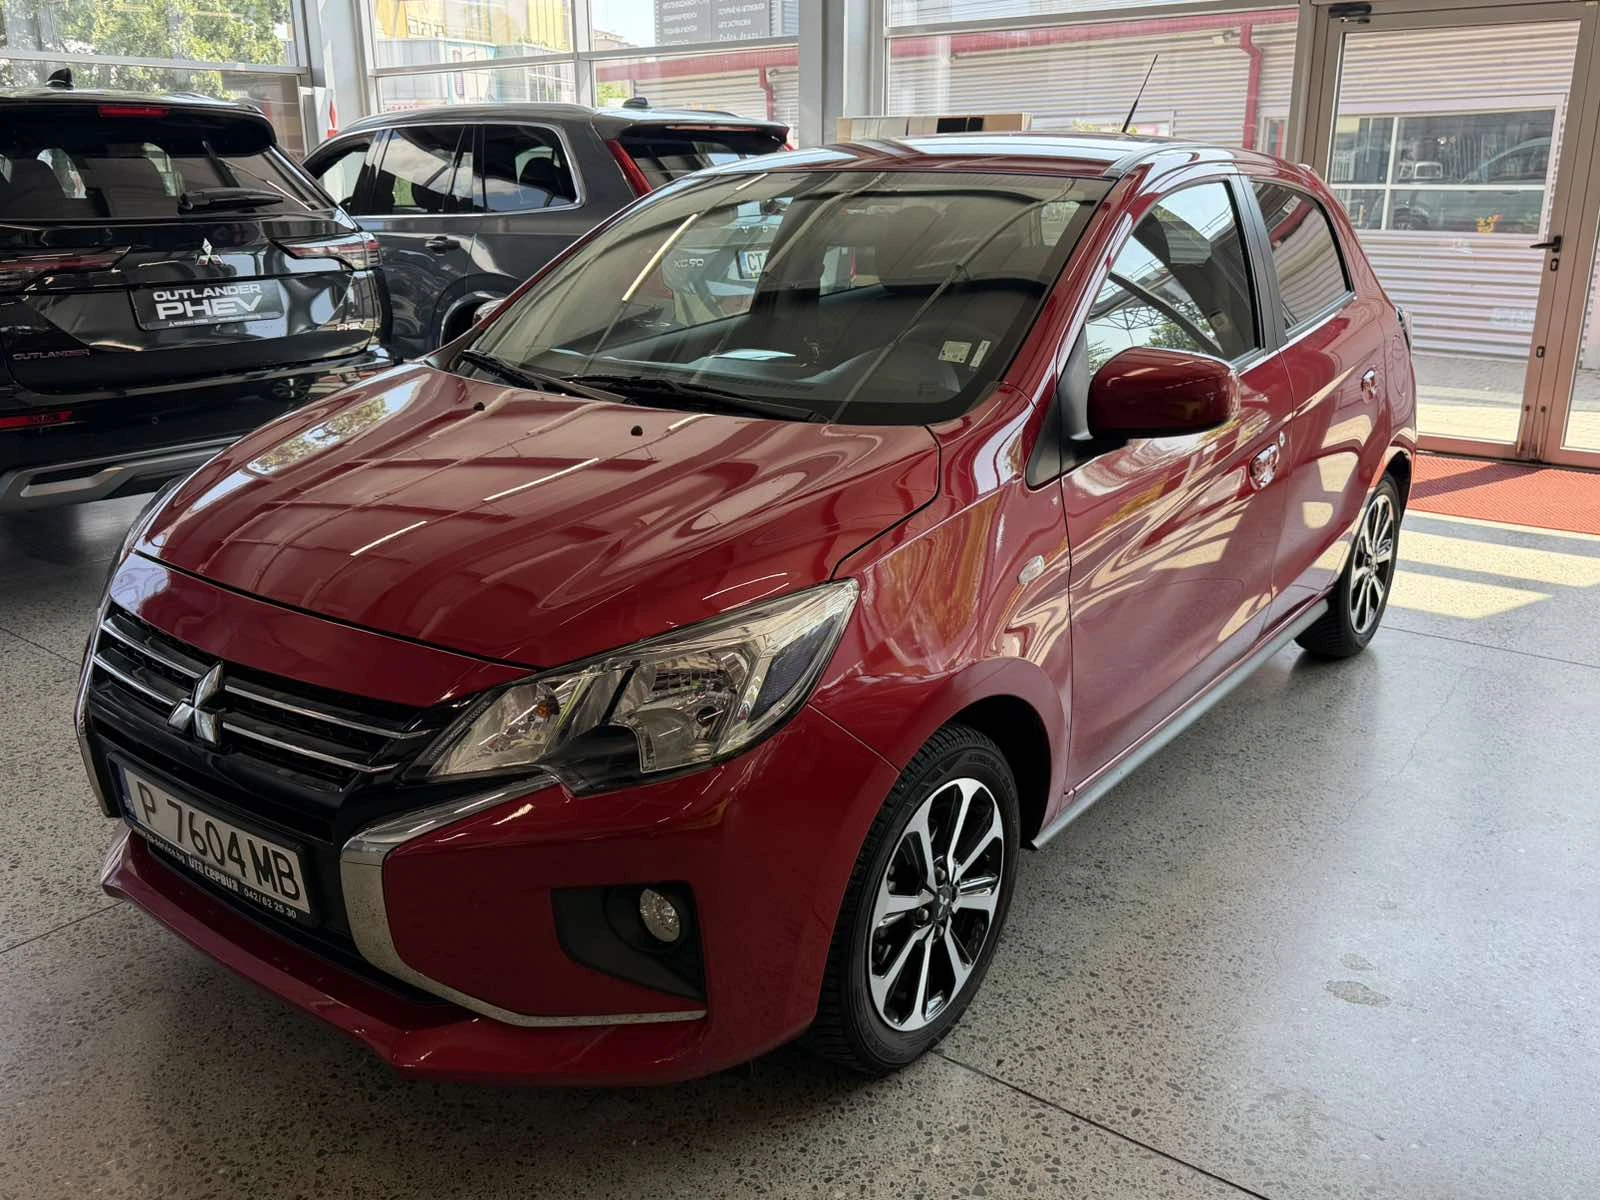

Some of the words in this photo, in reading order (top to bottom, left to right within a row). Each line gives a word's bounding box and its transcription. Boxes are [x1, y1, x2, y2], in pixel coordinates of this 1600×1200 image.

[152, 283, 263, 301] OUTLANDER
[155, 294, 263, 320] PHEV
[137, 780, 156, 826] P
[166, 798, 247, 878] 7604
[247, 838, 300, 901] MB
